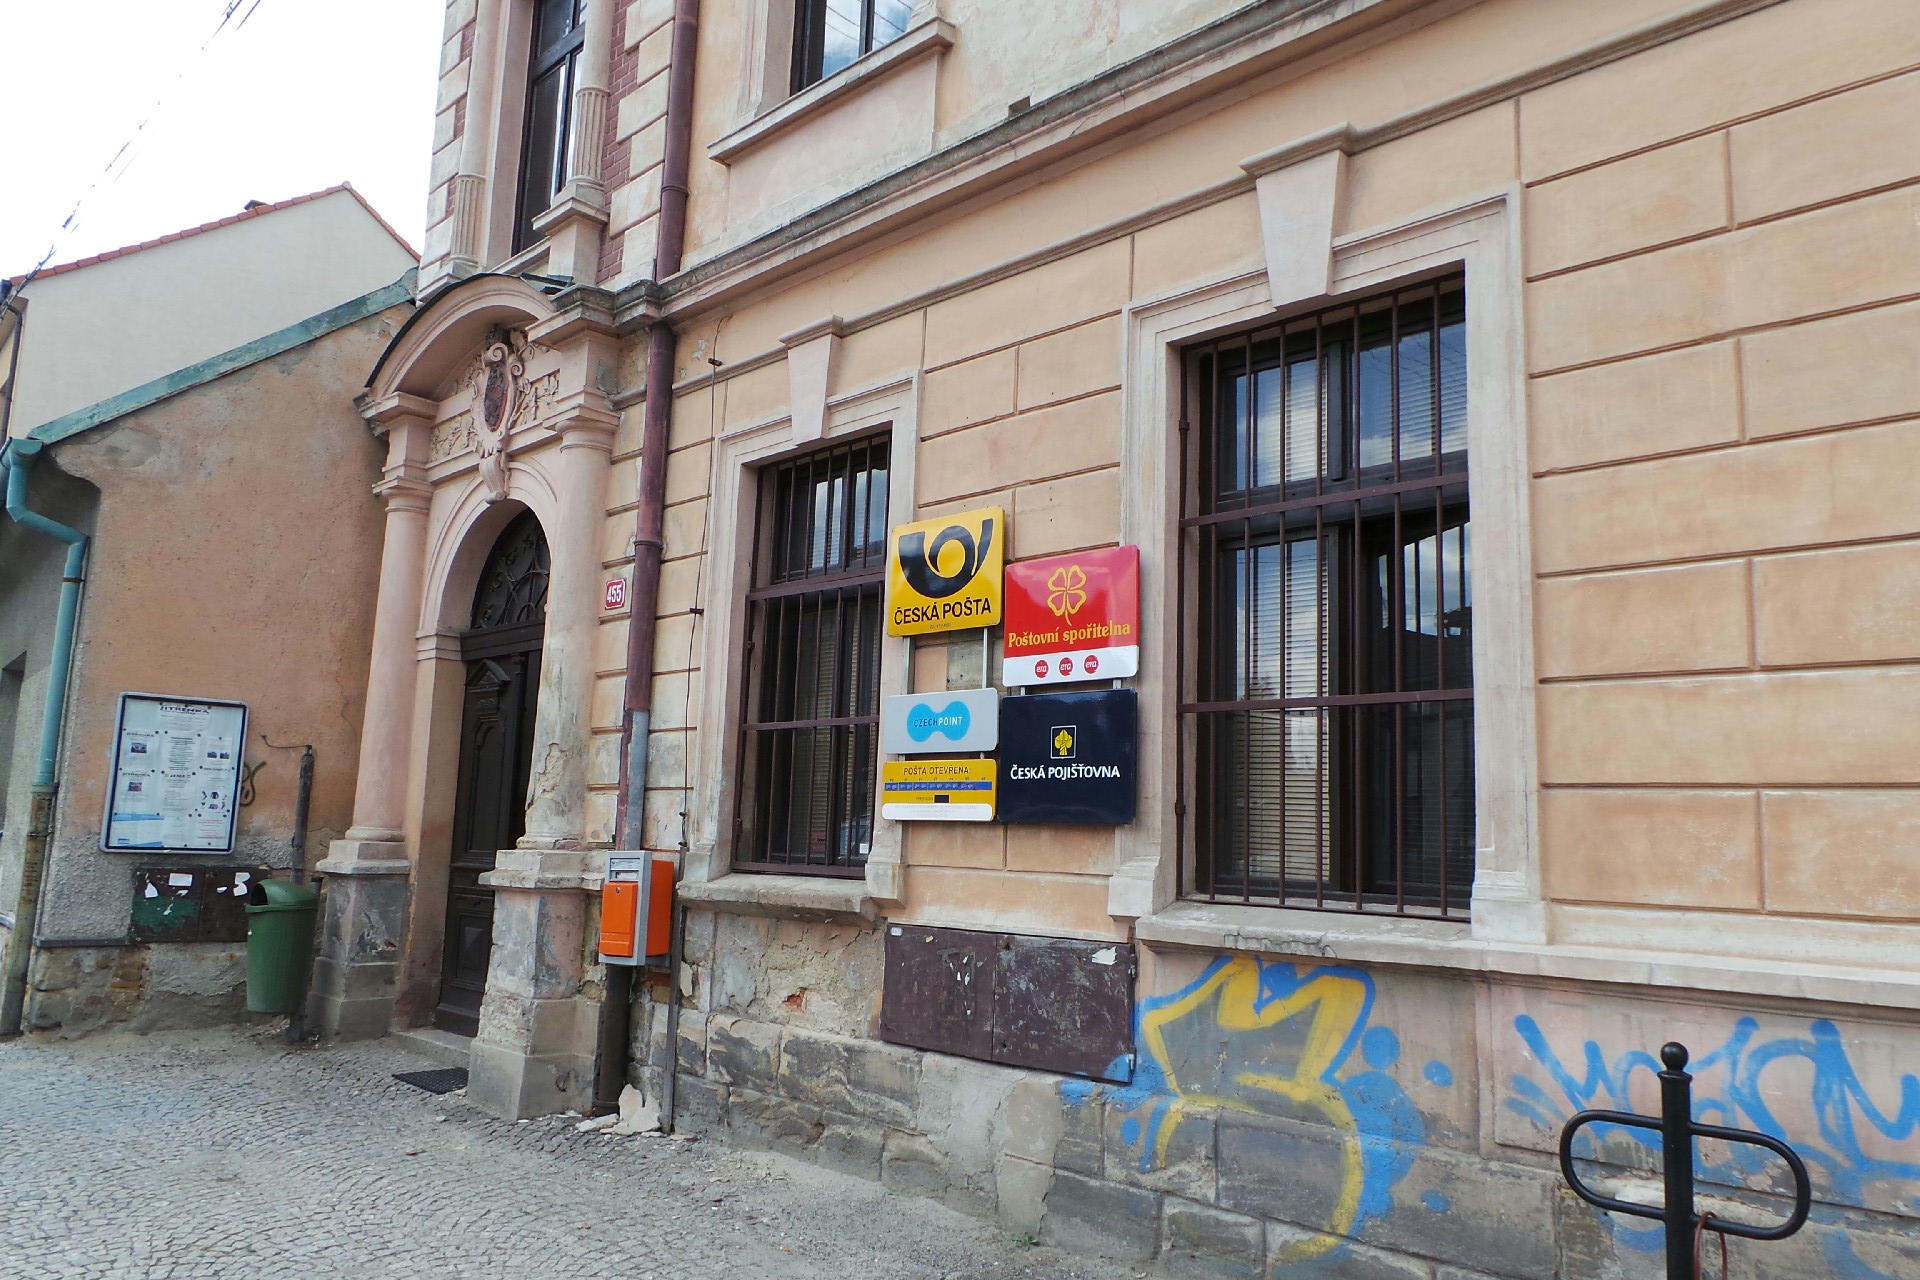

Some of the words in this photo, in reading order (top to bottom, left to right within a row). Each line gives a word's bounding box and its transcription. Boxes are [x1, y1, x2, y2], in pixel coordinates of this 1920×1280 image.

[606, 584, 622, 603] 455
[894, 602, 939, 626] ČESKÁ
[942, 597, 992, 619] POŠTA
[1008, 627, 1059, 647] Poštovní
[1062, 620, 1131, 644] spořitelna
[903, 765, 927, 776] POŠTA
[929, 764, 969, 775] OTEVŘENA
[1010, 764, 1046, 780] ČESKÁ
[1048, 763, 1121, 780] POJIŠŤOVNA
